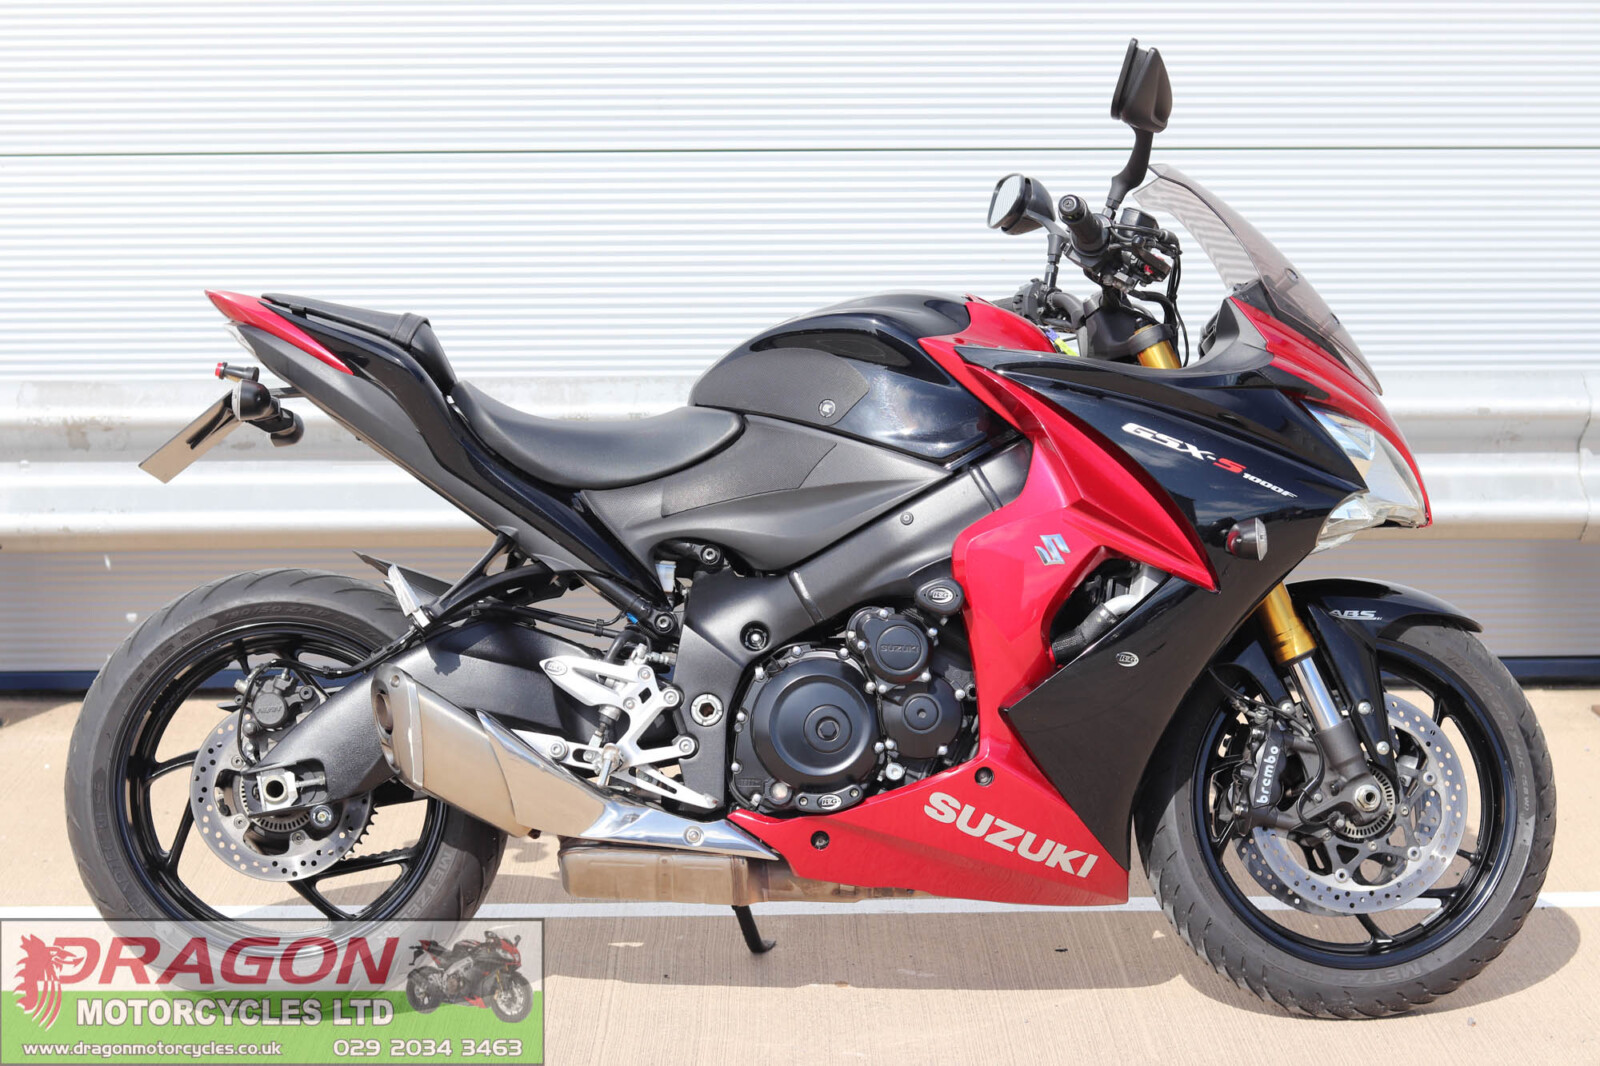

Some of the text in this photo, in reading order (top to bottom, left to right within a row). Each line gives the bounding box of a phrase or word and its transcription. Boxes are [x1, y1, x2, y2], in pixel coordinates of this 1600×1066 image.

[1329, 609, 1377, 620] ABS
[880, 643, 920, 653] SUZUKI
[1256, 745, 1279, 804] brembo
[923, 791, 1099, 878] SUZUKI
